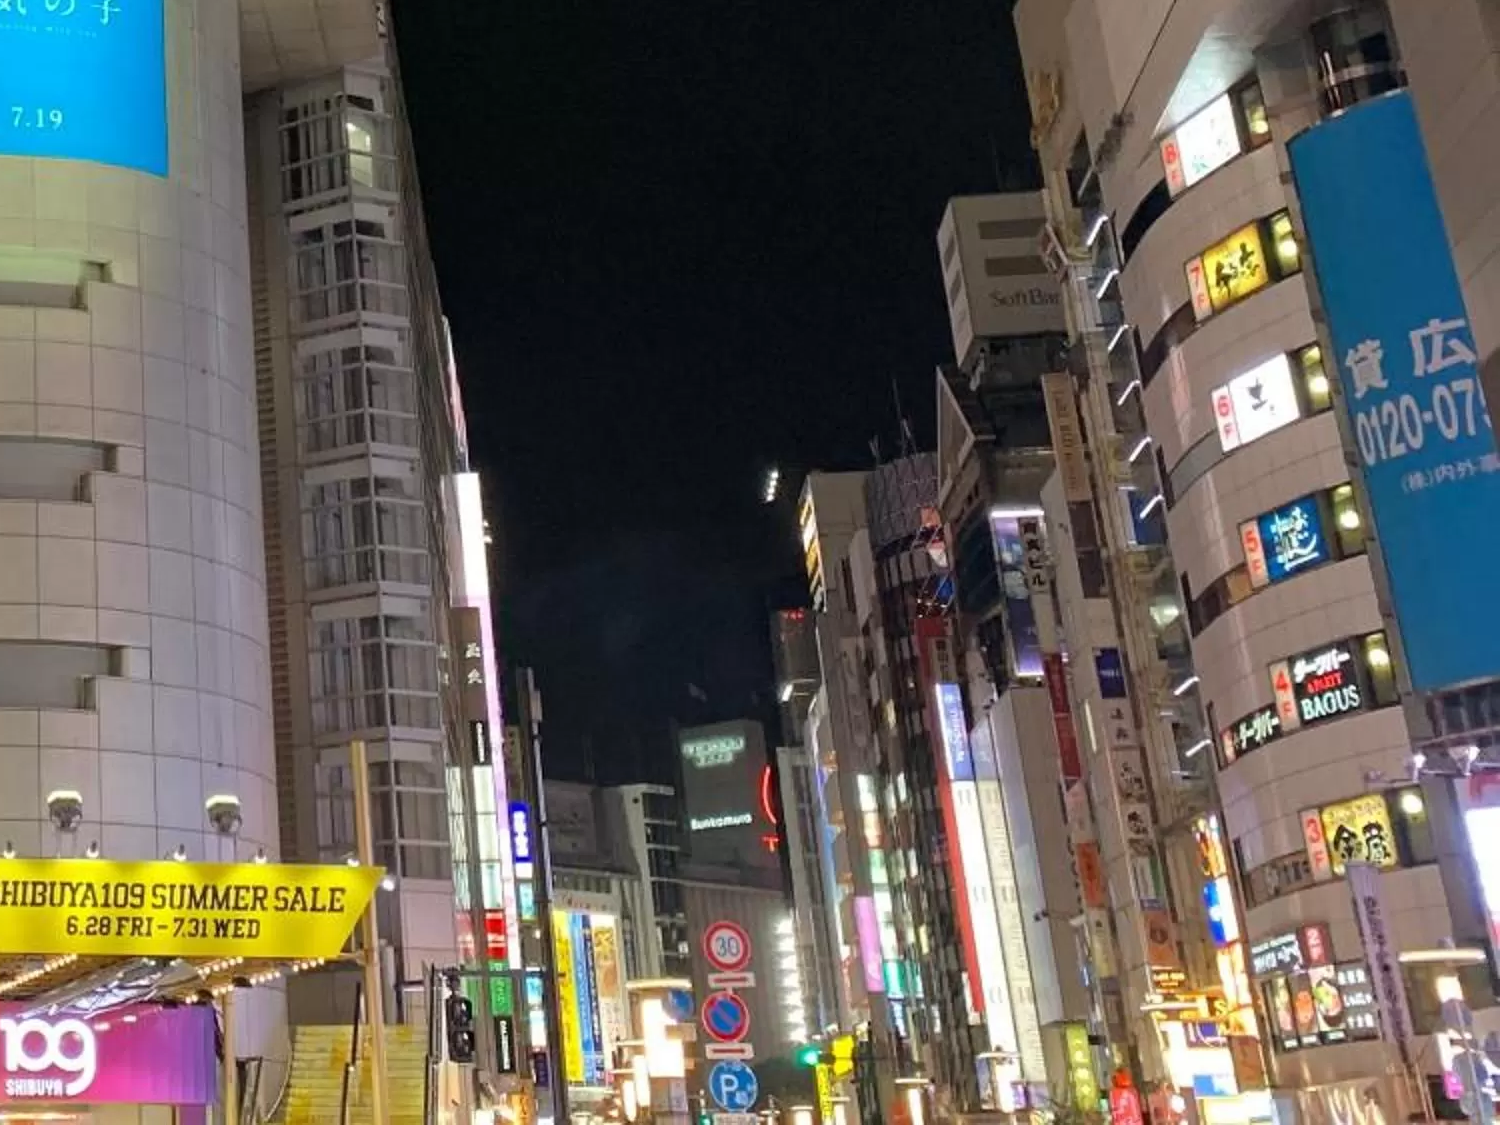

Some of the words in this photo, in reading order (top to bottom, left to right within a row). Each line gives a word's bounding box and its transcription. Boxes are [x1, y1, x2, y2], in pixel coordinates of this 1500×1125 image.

[11, 106, 63, 130] 7.19
[988, 286, 1062, 307] SoftBan
[1356, 378, 1492, 467] 0120-07
[1275, 669, 1294, 717] 4F
[1300, 684, 1361, 722] BAGUS
[152, 883, 269, 913] SUMMER
[273, 885, 347, 914] SALE
[65, 915, 111, 937] 6.28
[115, 916, 154, 938] FRI
[172, 917, 209, 939] 7.31
[212, 917, 262, 940] WED
[714, 935, 741, 959] 30
[5, 1079, 65, 1097] SHIBUYA
[720, 1075, 740, 1101] P
